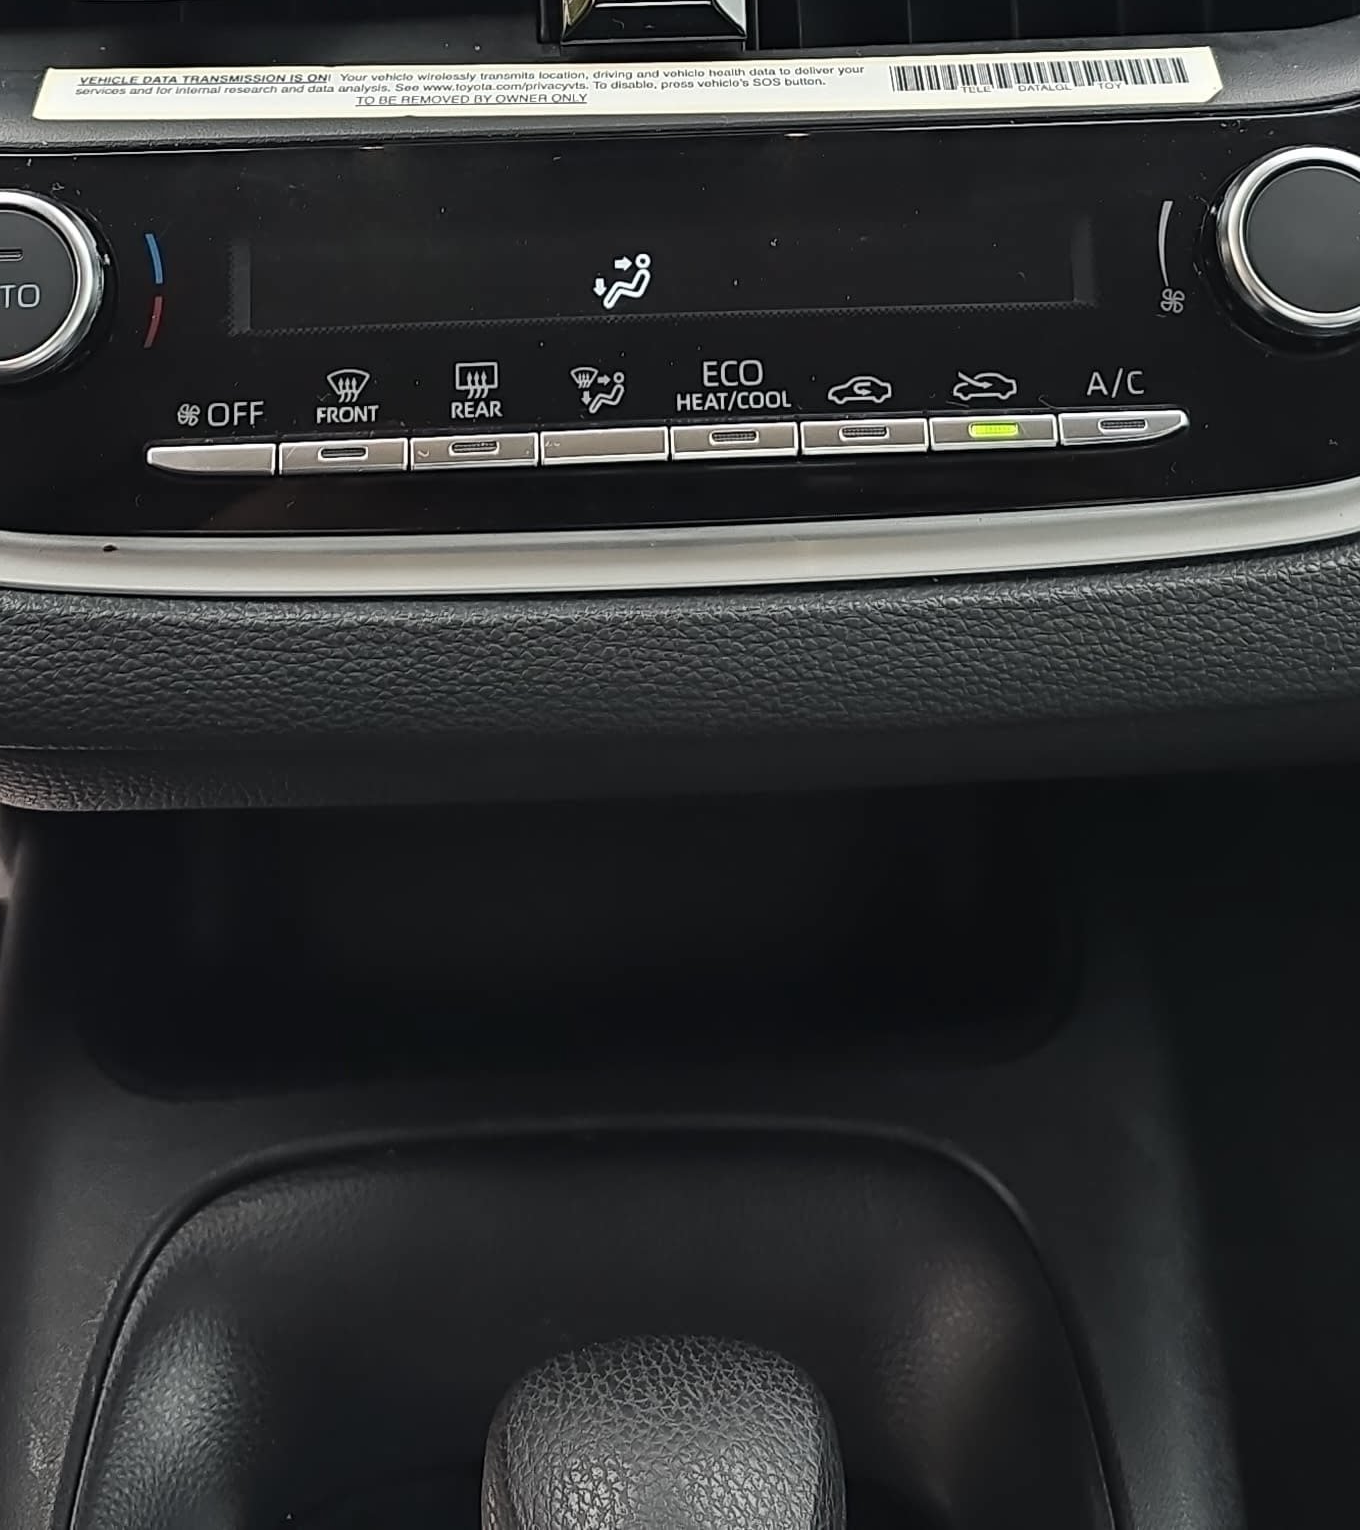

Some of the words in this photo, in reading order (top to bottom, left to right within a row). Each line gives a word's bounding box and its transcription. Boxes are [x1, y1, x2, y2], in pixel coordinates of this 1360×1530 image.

[79, 76, 138, 85] VEHICLE
[143, 75, 178, 84] DATA
[183, 74, 287, 84] TRANSMISSION
[290, 73, 303, 83] IS
[340, 72, 367, 82] Your
[371, 72, 414, 82] vehicle
[417, 71, 476, 83] wirelessly
[480, 70, 535, 81] transmits
[539, 70, 589, 81] location,
[592, 69, 633, 81] driving
[636, 69, 659, 79] and
[663, 68, 705, 78] vehicle
[709, 67, 745, 77] health
[749, 67, 776, 77] data
[779, 67, 791, 76] to
[794, 66, 834, 76] deliver
[837, 65, 865, 77] your
[75, 86, 126, 95] services
[129, 85, 152, 95] and
[224, 84, 278, 94] research
[281, 84, 304, 94] and
[307, 83, 335, 93] data
[395, 82, 420, 92] See
[593, 81, 607, 90] To
[660, 81, 695, 90] press
[752, 78, 781, 87] SOS
[784, 77, 826, 87] button.
[355, 96, 375, 106] TO
[379, 95, 397, 105] BE
[400, 94, 470, 105] REMOVED
[474, 94, 492, 104] BY
[495, 93, 548, 104] OWNER
[551, 93, 588, 103] ONLY
[702, 359, 764, 388] ECO
[1085, 367, 1145, 398] A/C
[451, 400, 503, 420] REAR
[676, 389, 792, 413] HEAT/COOL
[207, 400, 266, 427] OFF
[316, 404, 379, 425] FRONT
